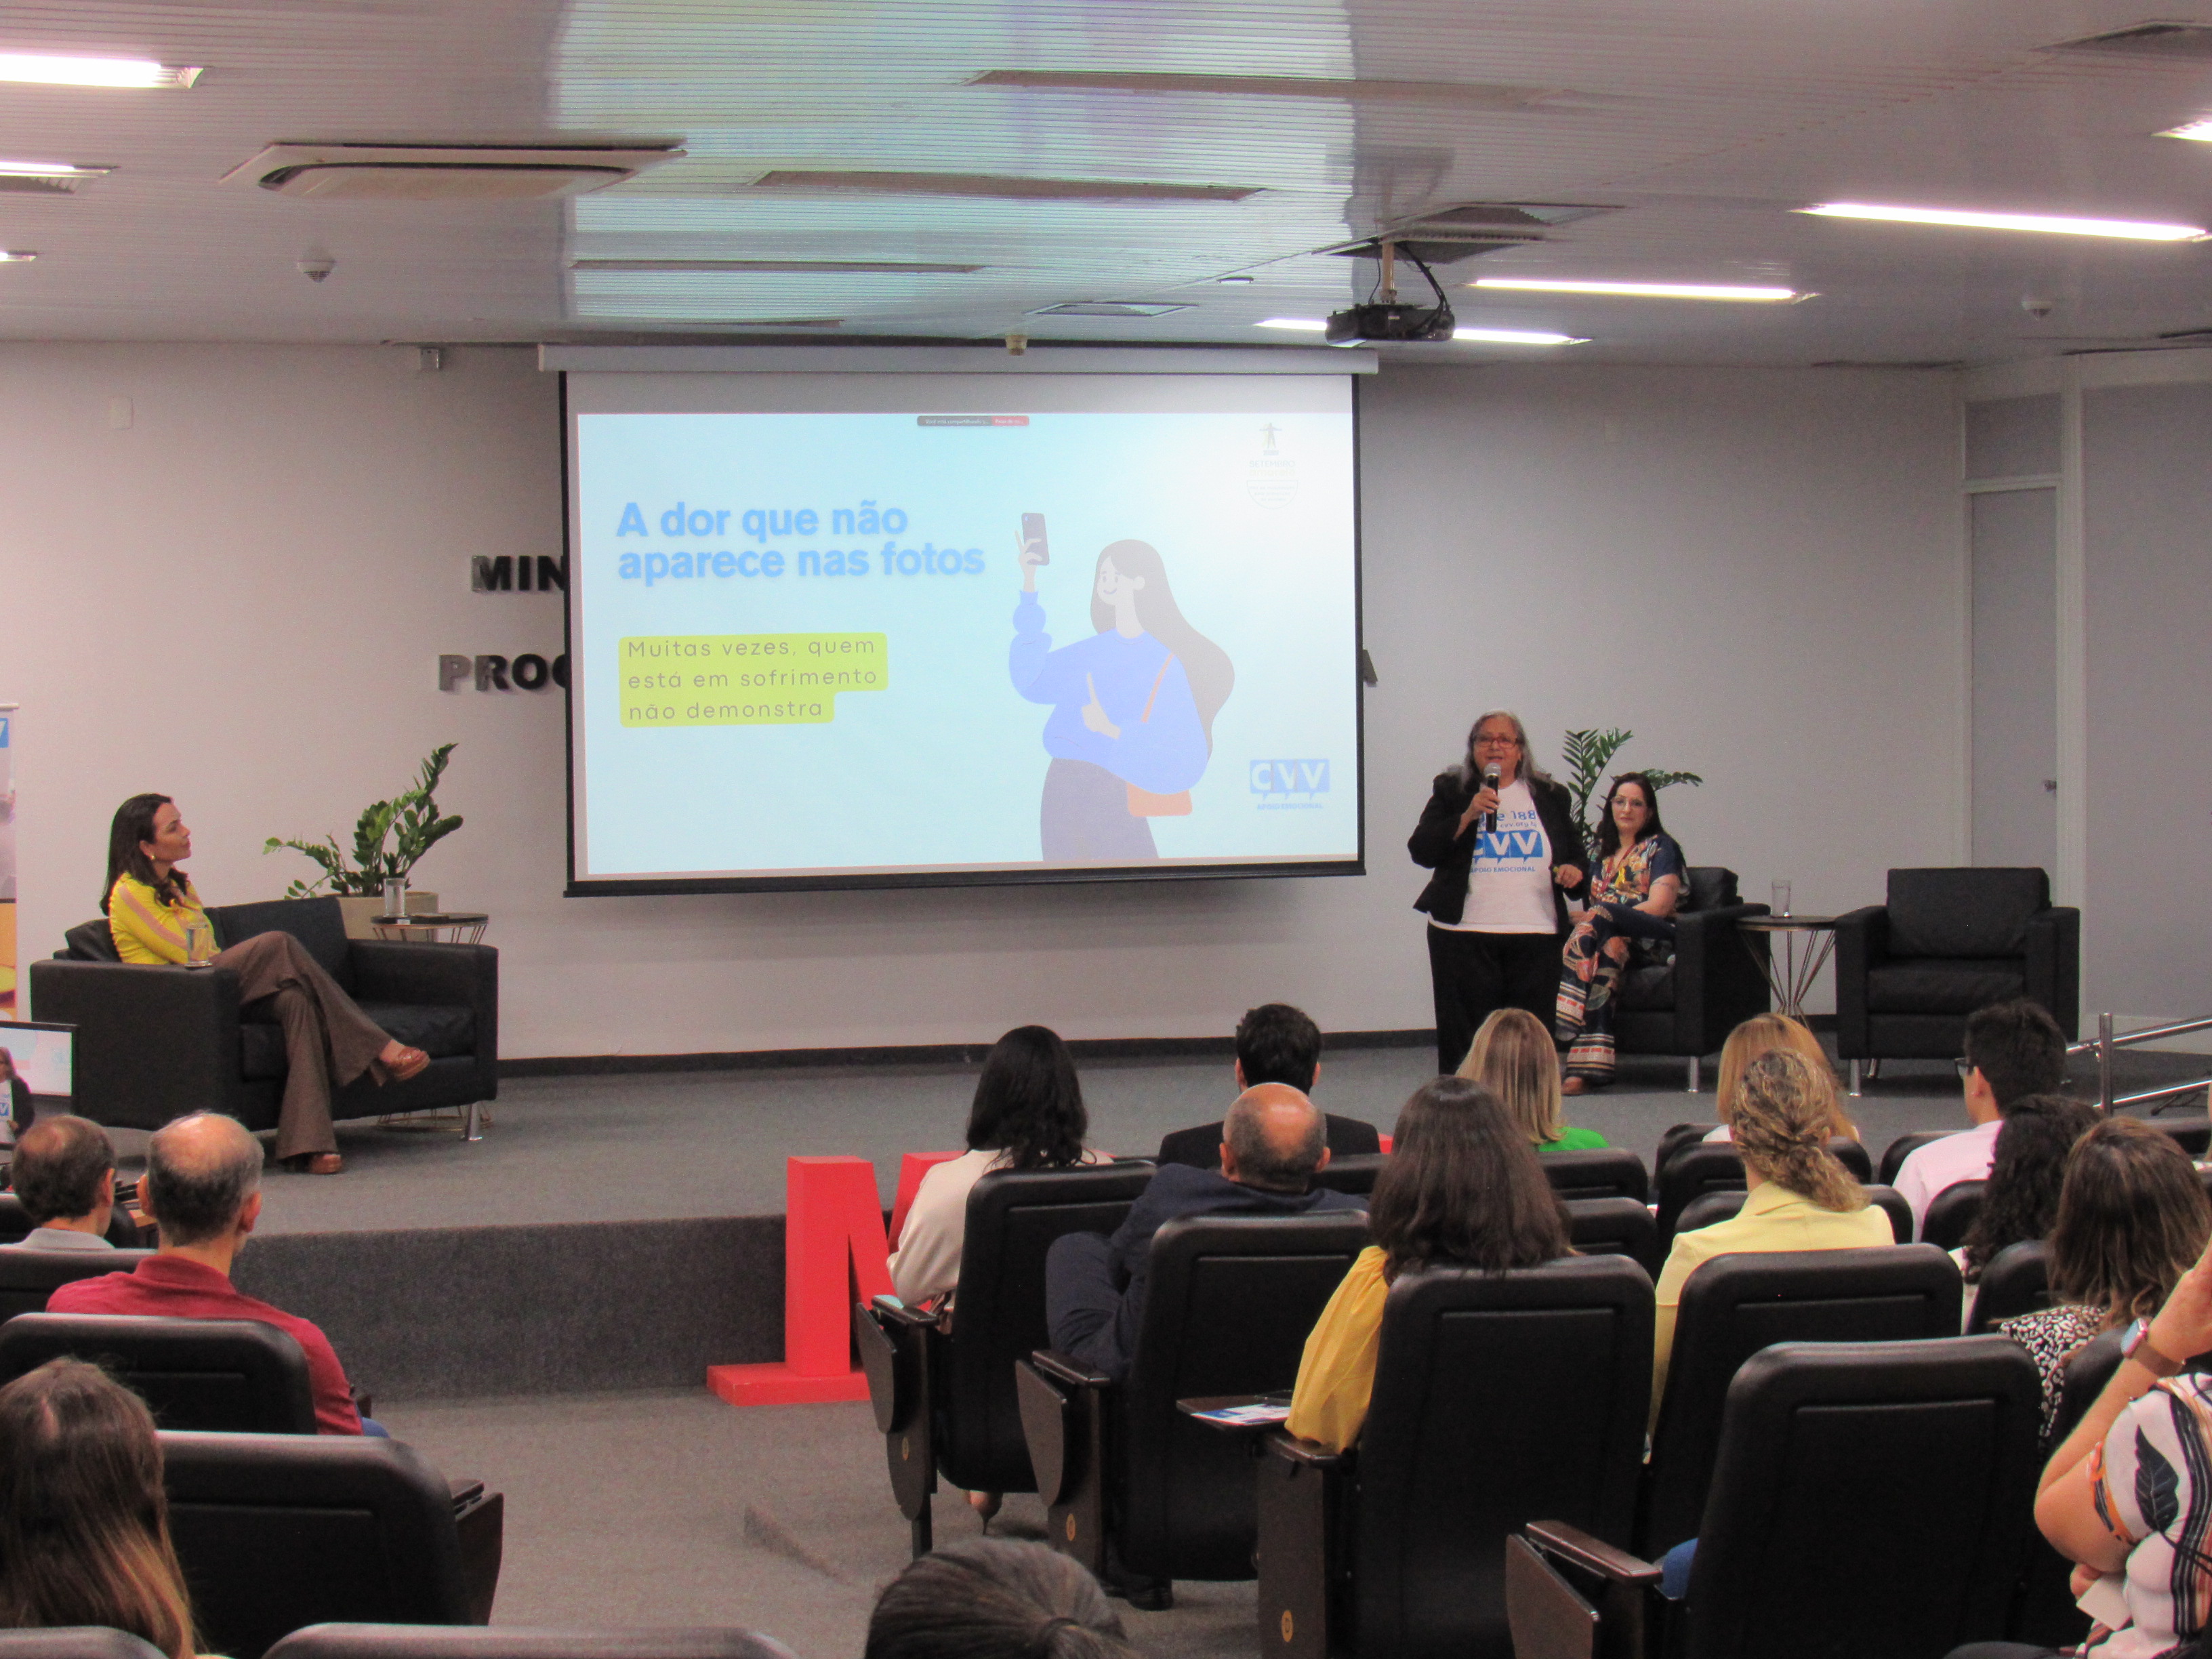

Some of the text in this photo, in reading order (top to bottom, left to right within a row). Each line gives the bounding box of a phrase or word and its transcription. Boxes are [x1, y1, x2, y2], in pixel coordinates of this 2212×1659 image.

[616, 499, 909, 544] A dor que não
[618, 541, 986, 588] aparece nas fotos
[628, 640, 874, 657] Muitas vezes, quem
[628, 668, 877, 689] está em sofrimento
[630, 701, 822, 720] não demonstra
[1251, 762, 1326, 791] CVV
[1511, 810, 1536, 821] 188
